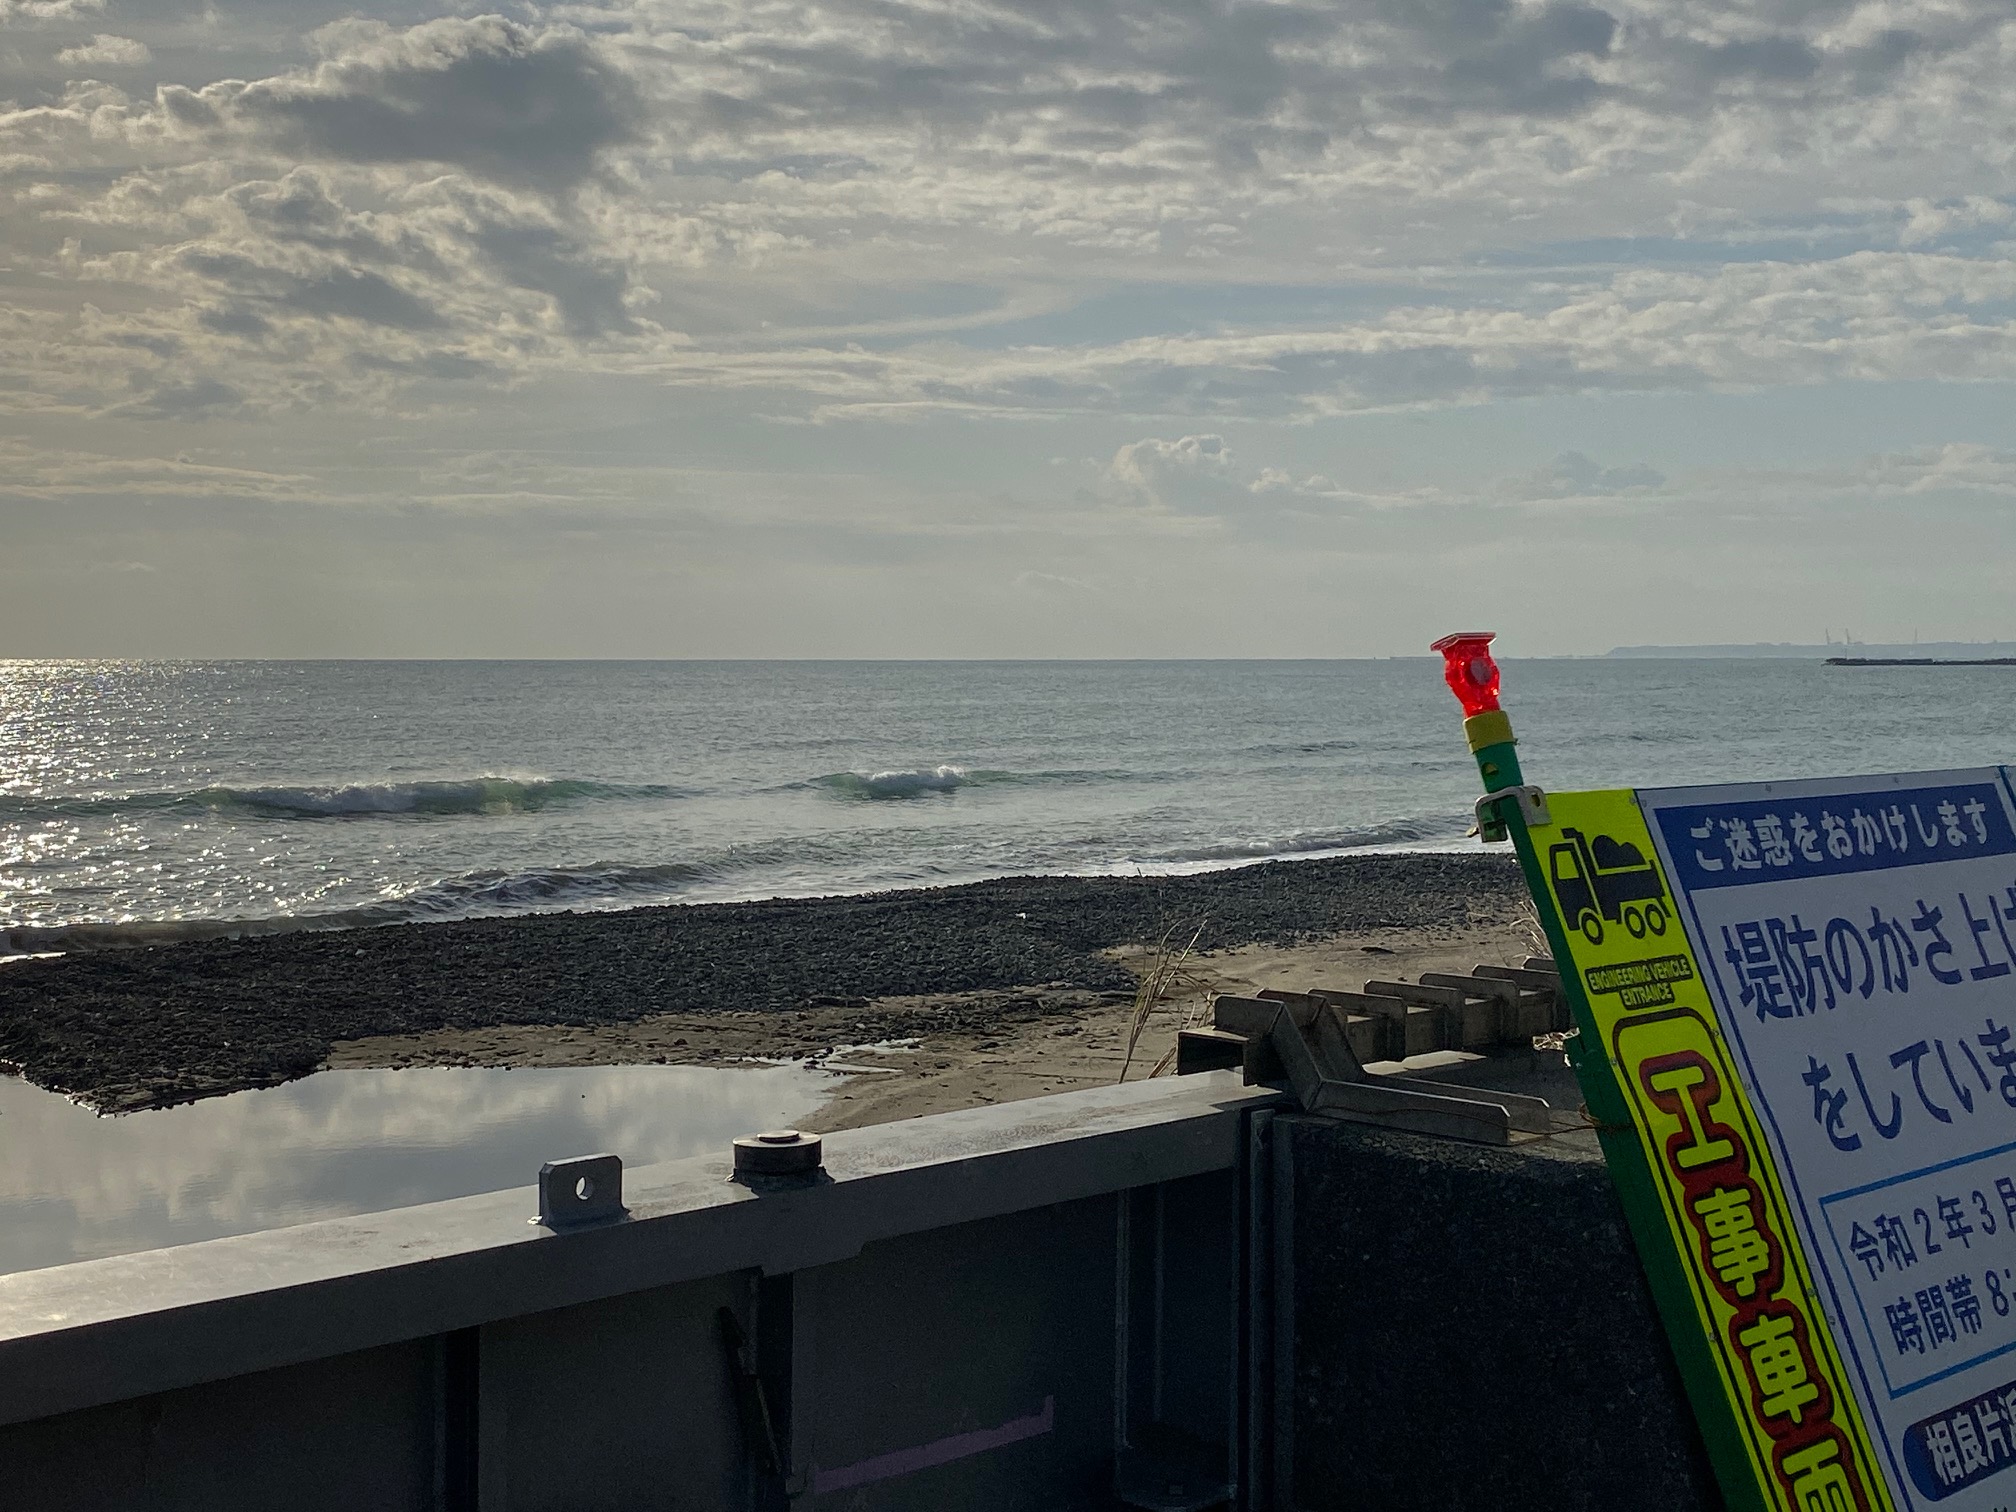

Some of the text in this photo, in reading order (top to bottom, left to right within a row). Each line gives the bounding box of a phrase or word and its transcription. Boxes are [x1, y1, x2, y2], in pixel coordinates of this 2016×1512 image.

[1690, 798, 1987, 870] ご迷惑をおかけします
[1588, 958, 1691, 990] ENGINEERING VEHICLE
[1621, 982, 1672, 1006] ENTRANCE
[1802, 1018, 2016, 1152] をしていま
[1884, 1274, 1982, 1356] 時間帯
